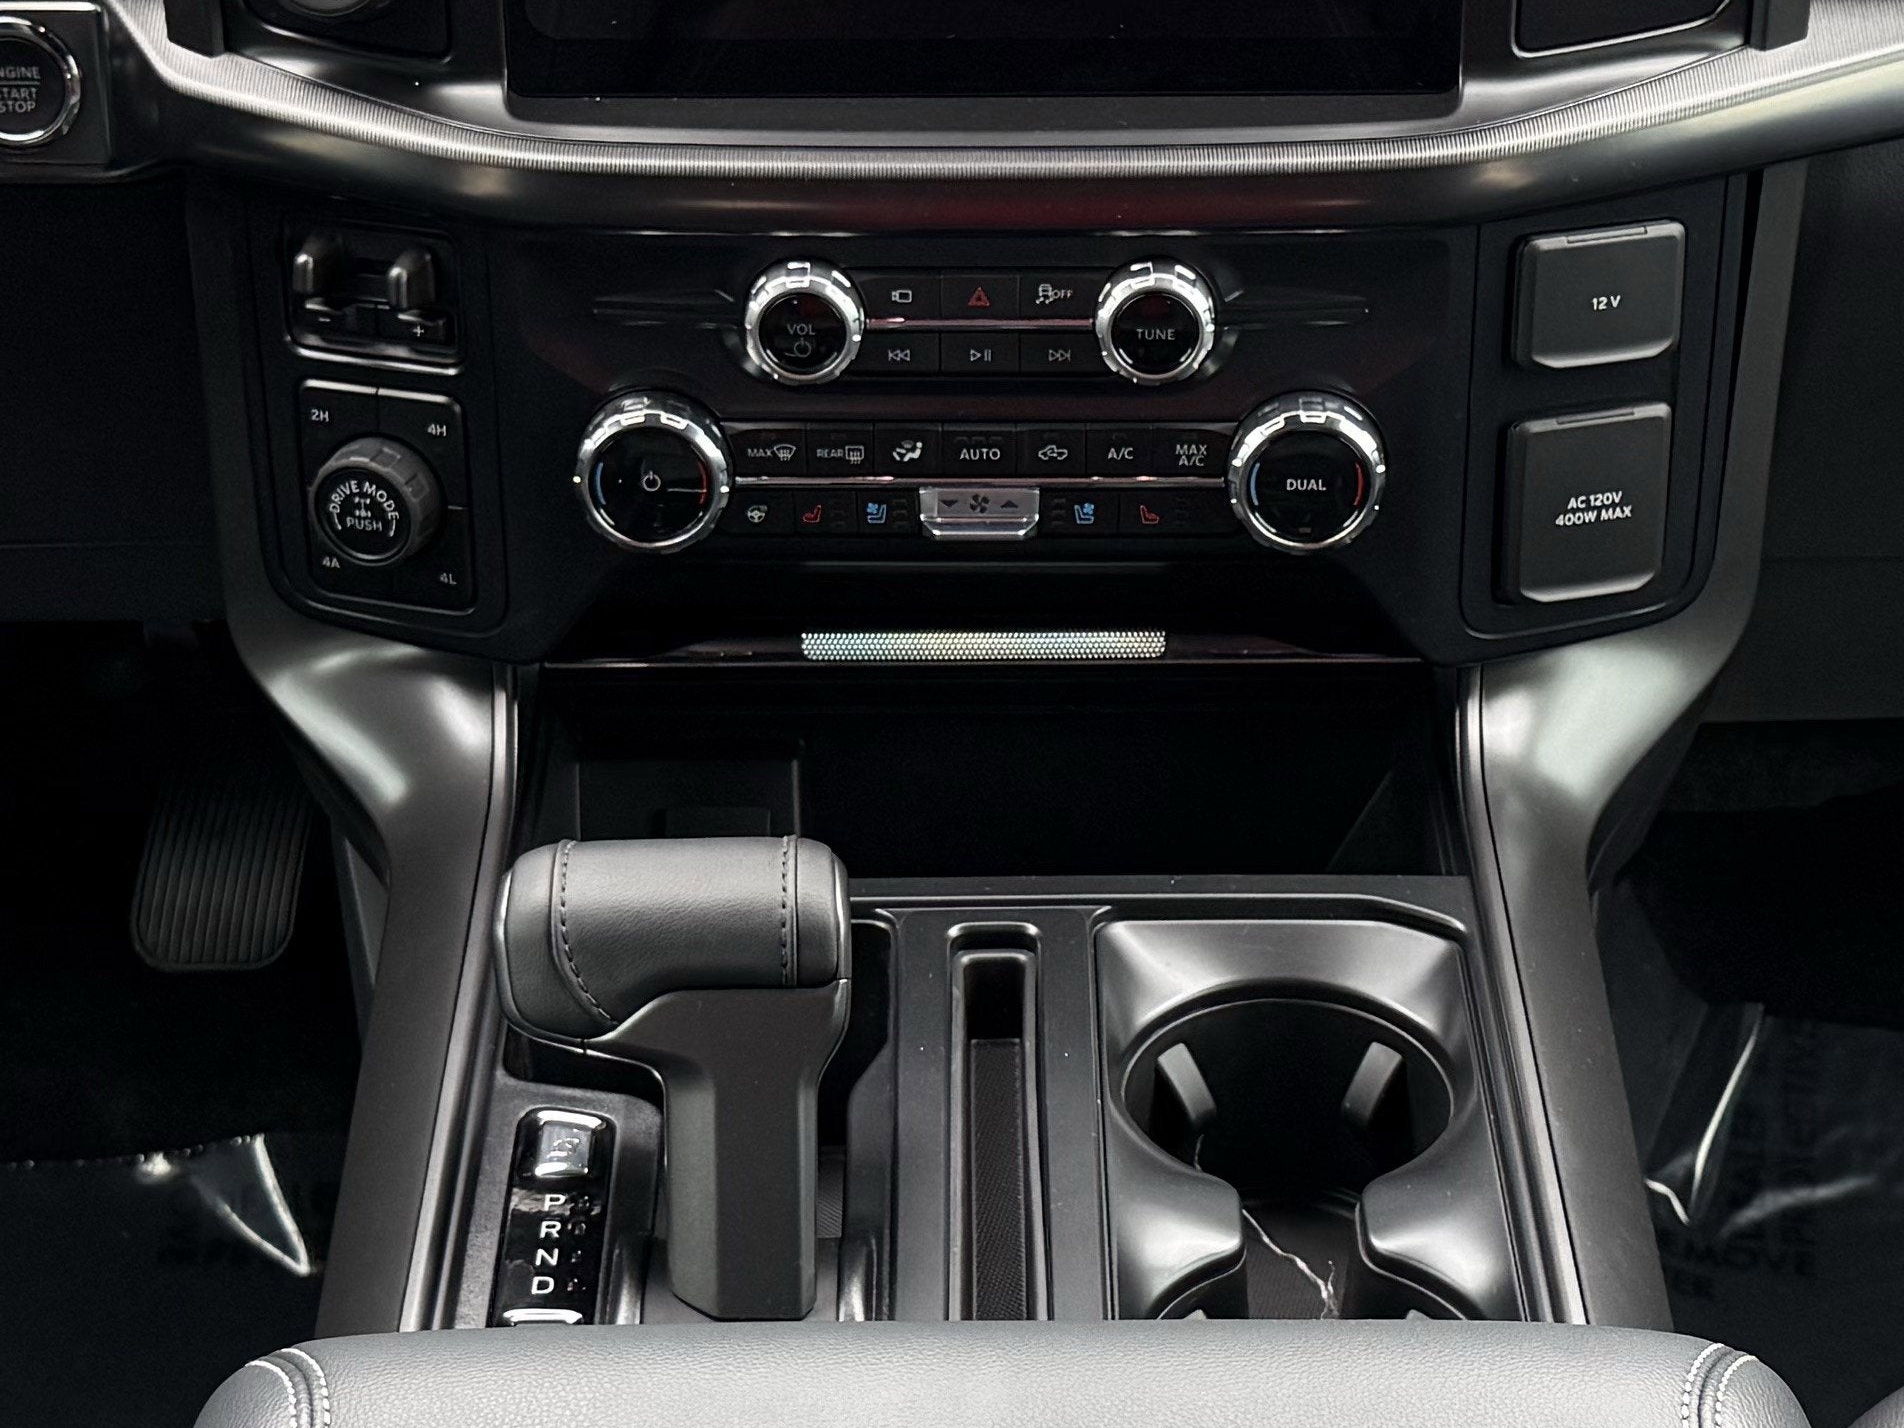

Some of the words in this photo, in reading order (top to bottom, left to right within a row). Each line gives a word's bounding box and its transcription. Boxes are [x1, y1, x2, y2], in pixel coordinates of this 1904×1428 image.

[1051, 288, 1073, 300] OFF
[1592, 296, 1608, 311] 12
[1610, 294, 1621, 308] V
[786, 323, 816, 336] VOL
[1136, 327, 1176, 341] TUNE
[310, 408, 330, 422] 2H
[427, 424, 447, 437] 4H
[747, 447, 773, 458] MAX
[816, 448, 844, 458] REAR
[959, 448, 1001, 461] AUTO
[1107, 447, 1134, 460] A/C
[1176, 444, 1207, 456] MAX
[1178, 455, 1205, 467] A/C
[1286, 478, 1327, 491] DUAL
[329, 480, 360, 514] DRIVE
[363, 481, 399, 521] MODE
[1567, 495, 1587, 510] AC
[1589, 491, 1623, 507] 120V
[1555, 509, 1597, 526] 400W
[1600, 505, 1632, 521] MAX
[346, 517, 383, 532] PUSH
[322, 556, 341, 569] 4A
[439, 572, 457, 586] 4L
[544, 1193, 566, 1212] P
[539, 1220, 562, 1238] R
[535, 1248, 559, 1267] N
[531, 1275, 555, 1295] D
